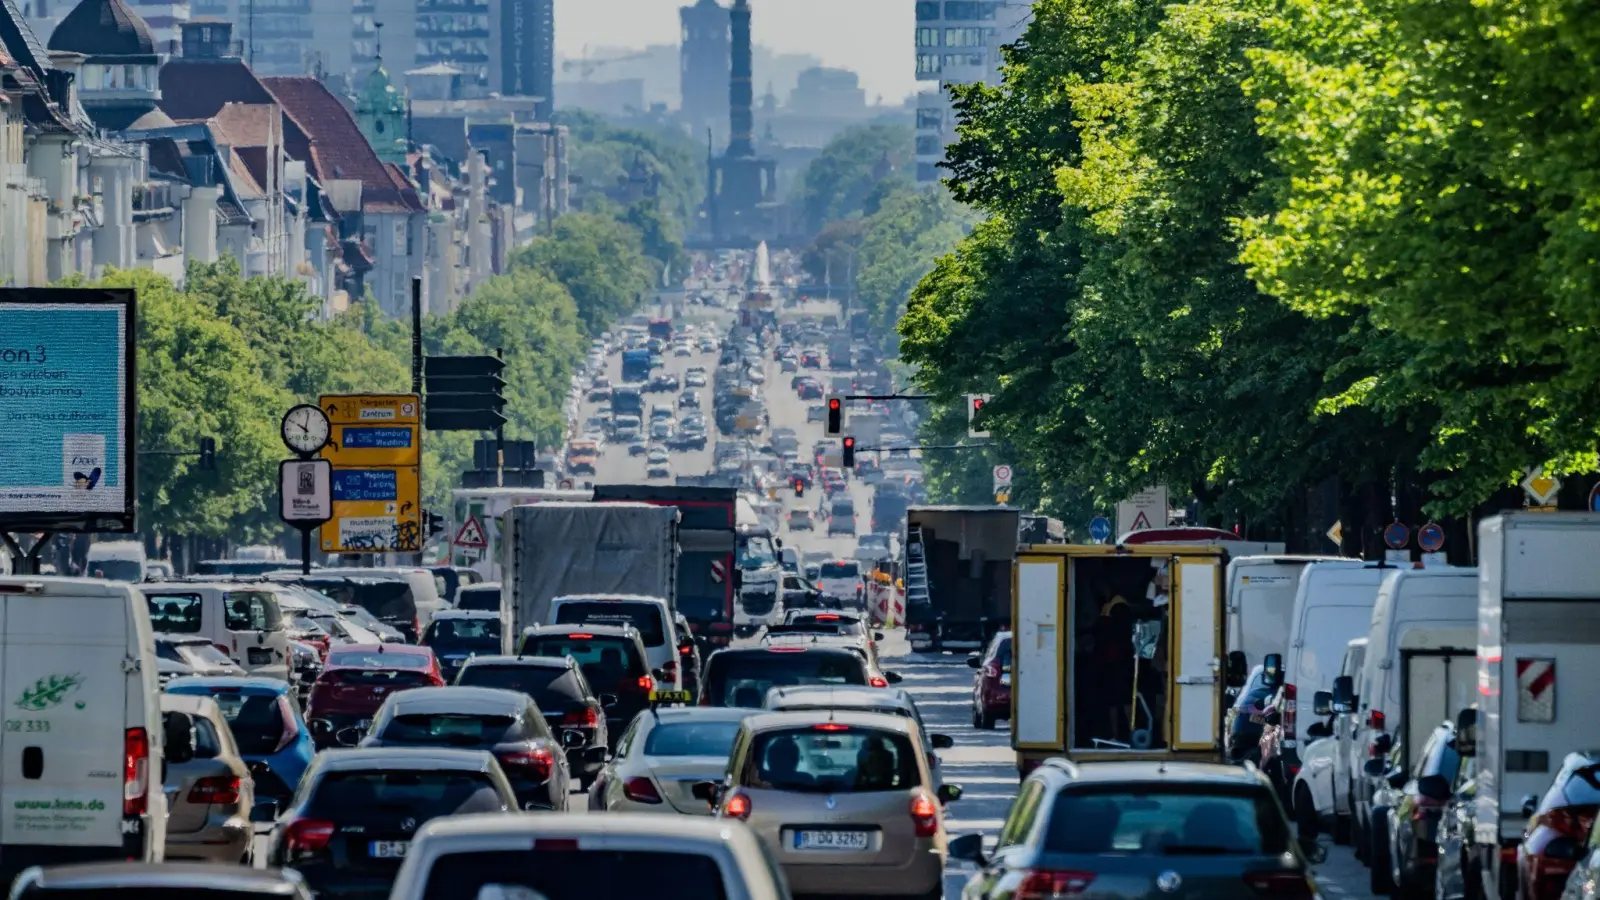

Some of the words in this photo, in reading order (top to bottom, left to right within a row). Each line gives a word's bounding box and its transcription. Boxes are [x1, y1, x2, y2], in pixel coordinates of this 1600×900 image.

[35, 345, 47, 363] 3
[362, 410, 393, 418] Zentrum
[374, 430, 410, 438] Hamburg
[375, 439, 409, 447] Wedding
[363, 490, 396, 498] Dresden
[657, 690, 685, 700] TAXI
[379, 842, 389, 856] B
